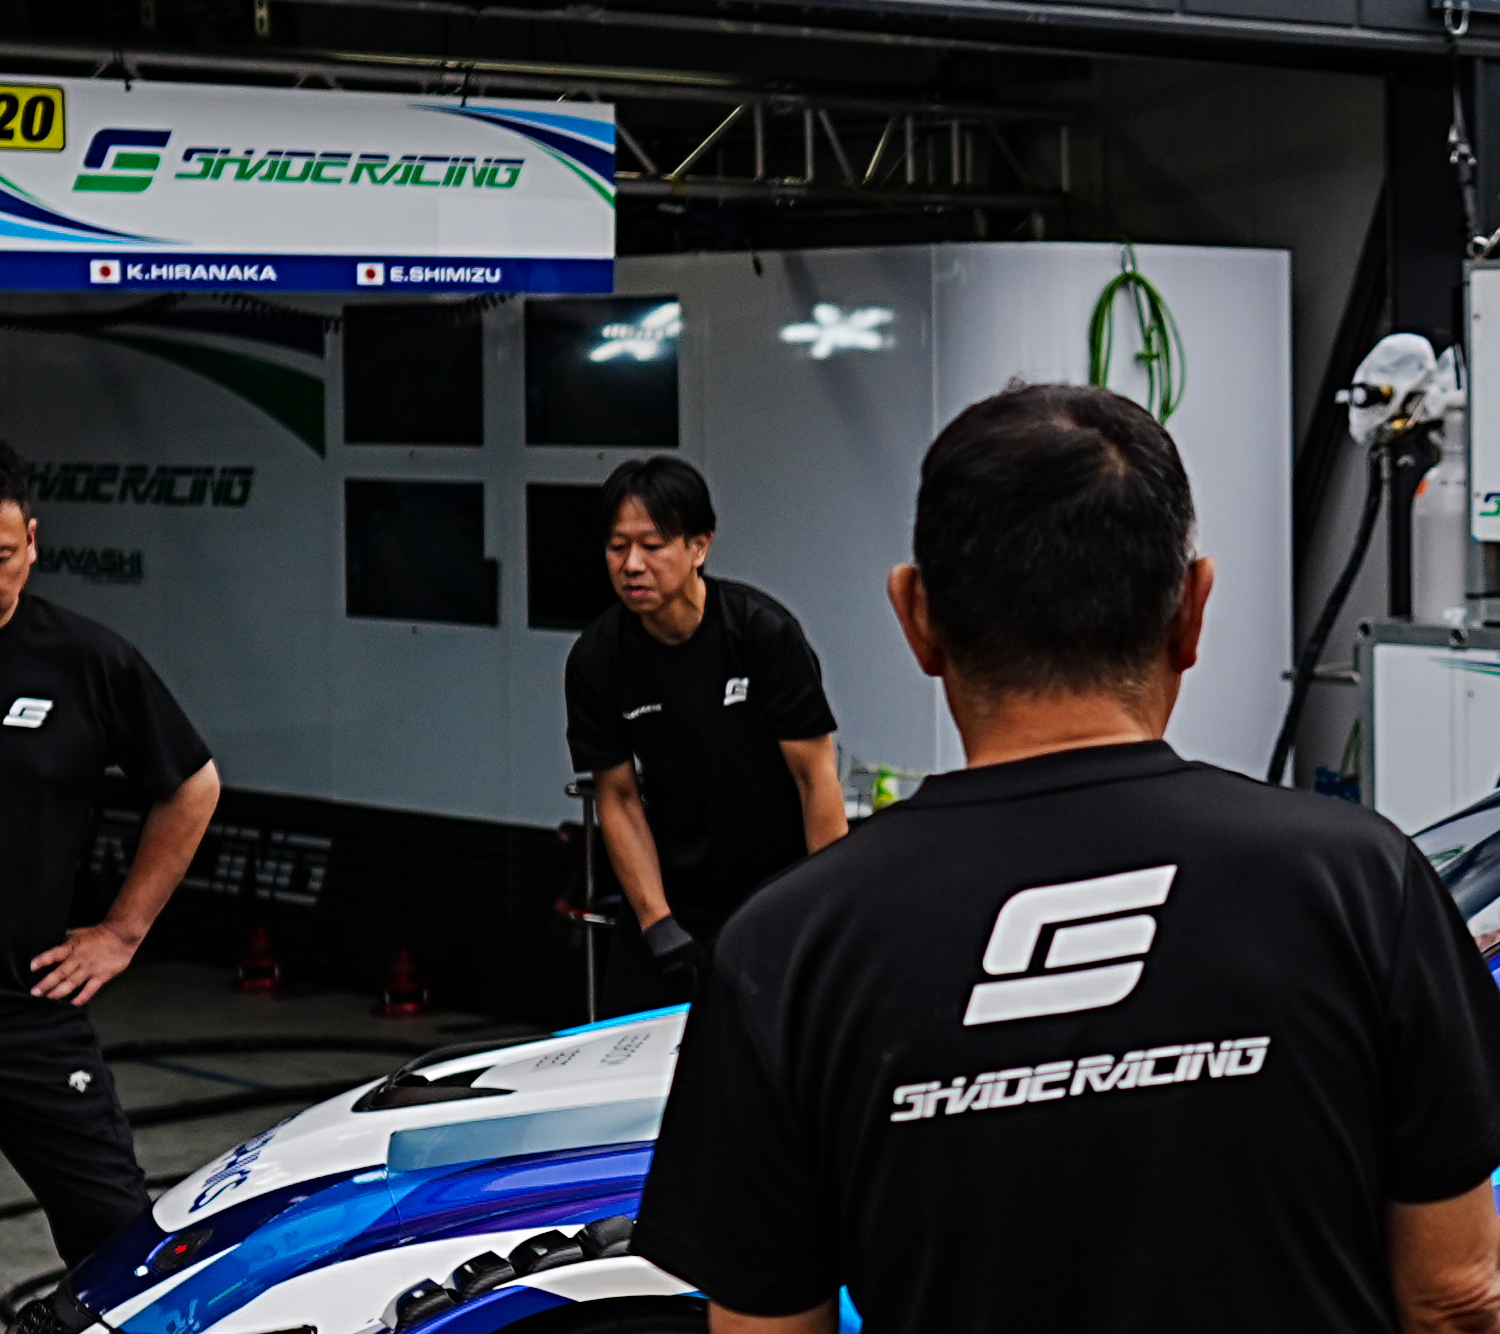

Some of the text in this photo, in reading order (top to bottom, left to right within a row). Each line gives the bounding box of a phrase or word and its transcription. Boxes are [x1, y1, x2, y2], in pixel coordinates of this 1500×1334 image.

[349, 152, 525, 189] RACING
[126, 264, 277, 282] K.HIRANAKA
[391, 267, 501, 284] E.SHIMIZU
[891, 1037, 1270, 1122] SHADE RACING
